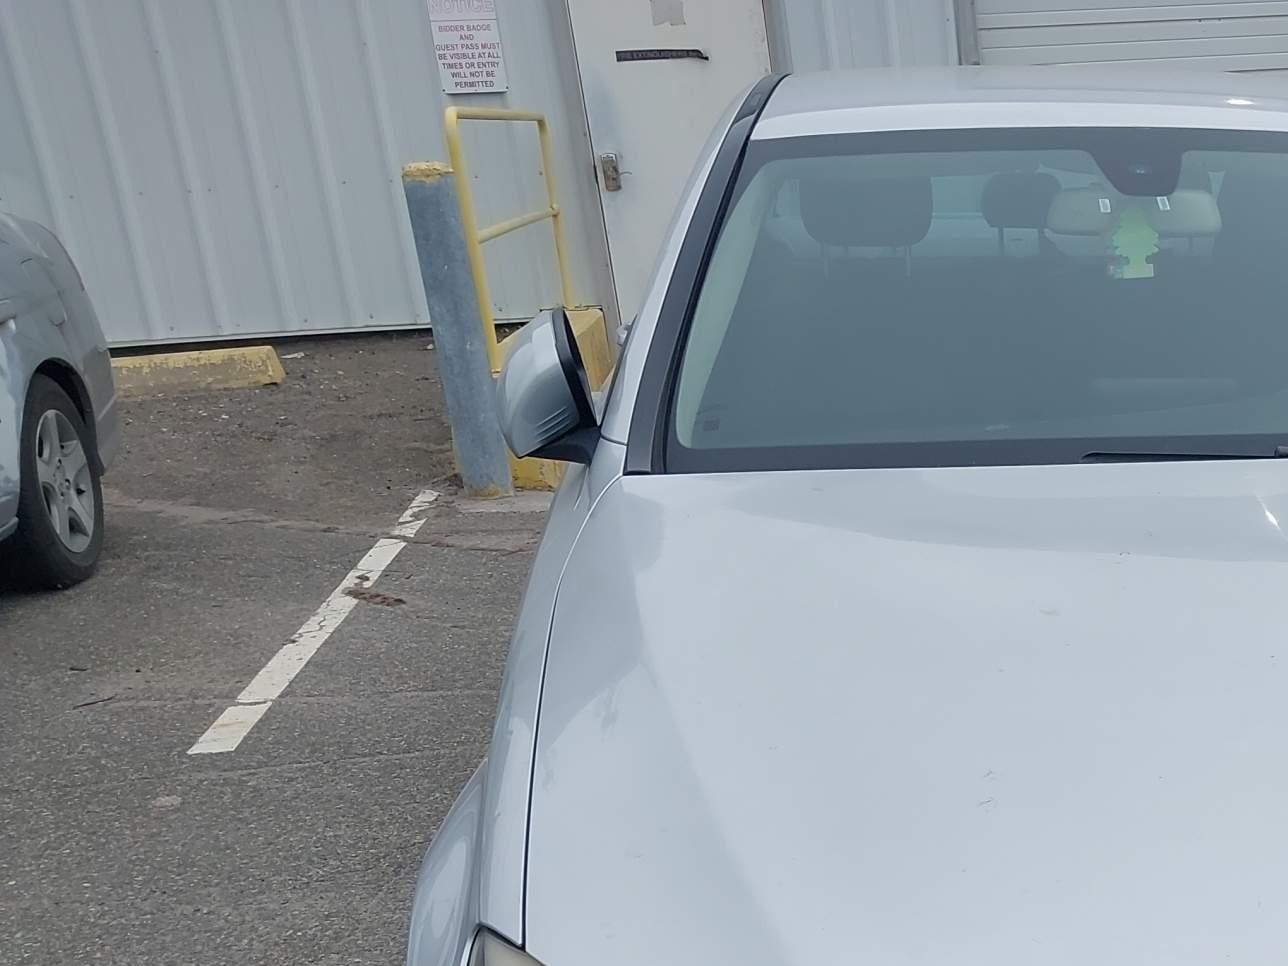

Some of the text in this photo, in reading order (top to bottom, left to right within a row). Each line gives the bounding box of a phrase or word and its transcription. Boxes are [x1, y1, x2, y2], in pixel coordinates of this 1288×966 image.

[438, 25, 465, 33] BIDDER
[435, 42, 500, 52] GUEST PASS MUST
[438, 51, 501, 61] BE VISIBLE AT ALL
[441, 61, 500, 70] TIMES OR ENTRY
[450, 70, 496, 79] WILL NOT BE
[454, 80, 495, 89] PERMITTED
